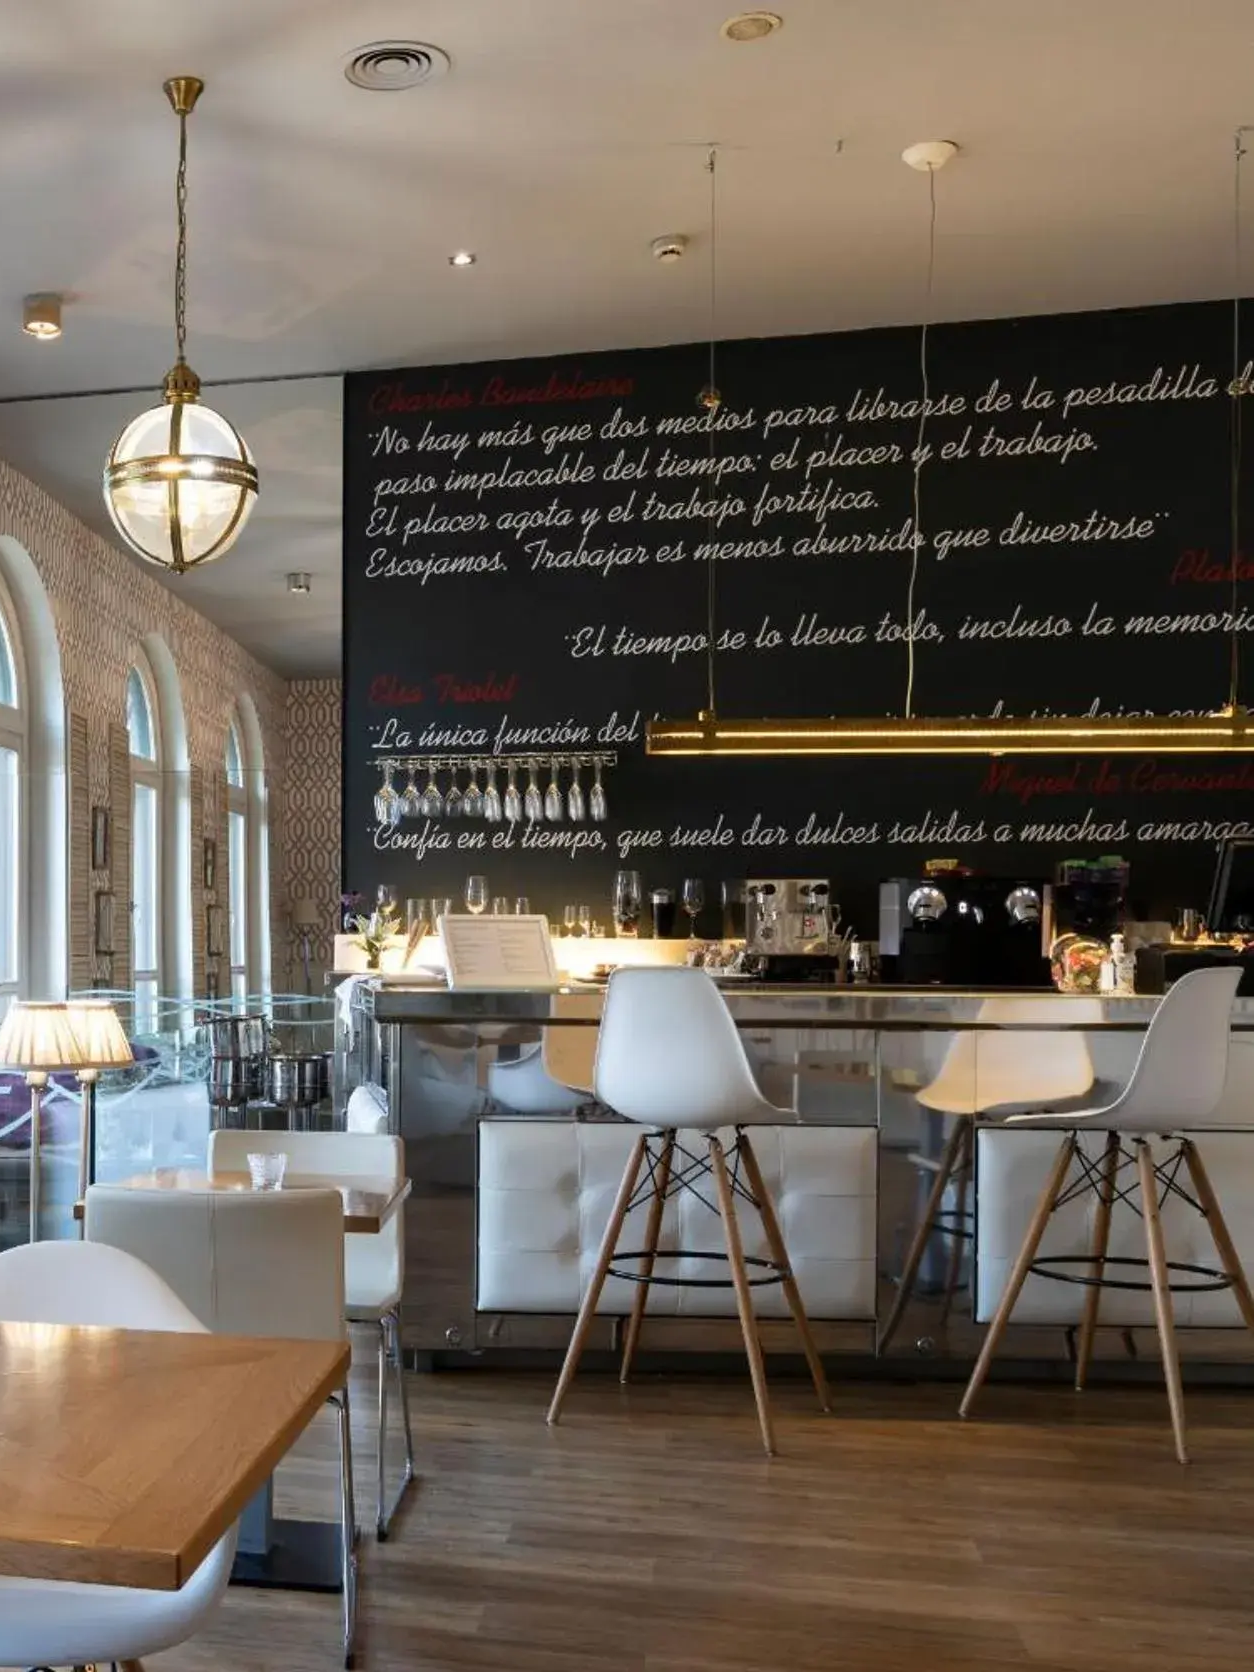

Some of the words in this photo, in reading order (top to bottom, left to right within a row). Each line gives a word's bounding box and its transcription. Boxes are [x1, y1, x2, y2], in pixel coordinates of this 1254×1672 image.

[417, 421, 469, 460] hay
[477, 421, 534, 450] más
[541, 424, 591, 455] que
[600, 407, 649, 440] dos
[655, 405, 755, 435] medios
[762, 402, 839, 439] para
[846, 387, 966, 422] librarse
[974, 378, 1013, 413] de
[1021, 376, 1055, 410] la
[1063, 364, 1219, 419] pesadilla
[374, 473, 437, 506] paso
[445, 453, 596, 500] implacable
[602, 447, 648, 482] del
[653, 453, 762, 486] tiempo:
[769, 437, 800, 471] el
[806, 433, 903, 479] placer
[910, 443, 933, 472] y
[940, 426, 973, 460] el
[978, 421, 1099, 465] trabajo.
[365, 507, 396, 538] El
[403, 503, 490, 545] placer
[496, 498, 573, 542] agota
[580, 511, 601, 540] y
[608, 490, 635, 524] el
[642, 486, 746, 528] trabajo
[752, 479, 879, 527] fortifica.
[365, 547, 509, 585] Escojamos.
[524, 536, 649, 577] Trabajar
[655, 544, 686, 564] es
[693, 536, 785, 562] menos
[792, 517, 926, 556] aburrido
[933, 525, 991, 560] que
[611, 624, 708, 663] tiempo
[716, 629, 746, 651] se
[755, 615, 783, 650] lo
[790, 612, 867, 647] lleva
[875, 607, 946, 643] todo,
[958, 603, 1073, 641] incluso
[1081, 601, 1116, 637] la
[418, 721, 489, 747] única
[493, 714, 591, 754] función
[597, 710, 641, 743] del
[457, 831, 487, 849] en
[492, 819, 515, 848] el
[522, 820, 608, 858] tiempo,
[617, 828, 662, 858] que
[669, 816, 735, 847] suele
[742, 814, 789, 847] dar
[795, 812, 881, 845] dulces
[887, 808, 988, 844] salidas
[993, 824, 1015, 842] a
[1019, 808, 1130, 842] muchas
